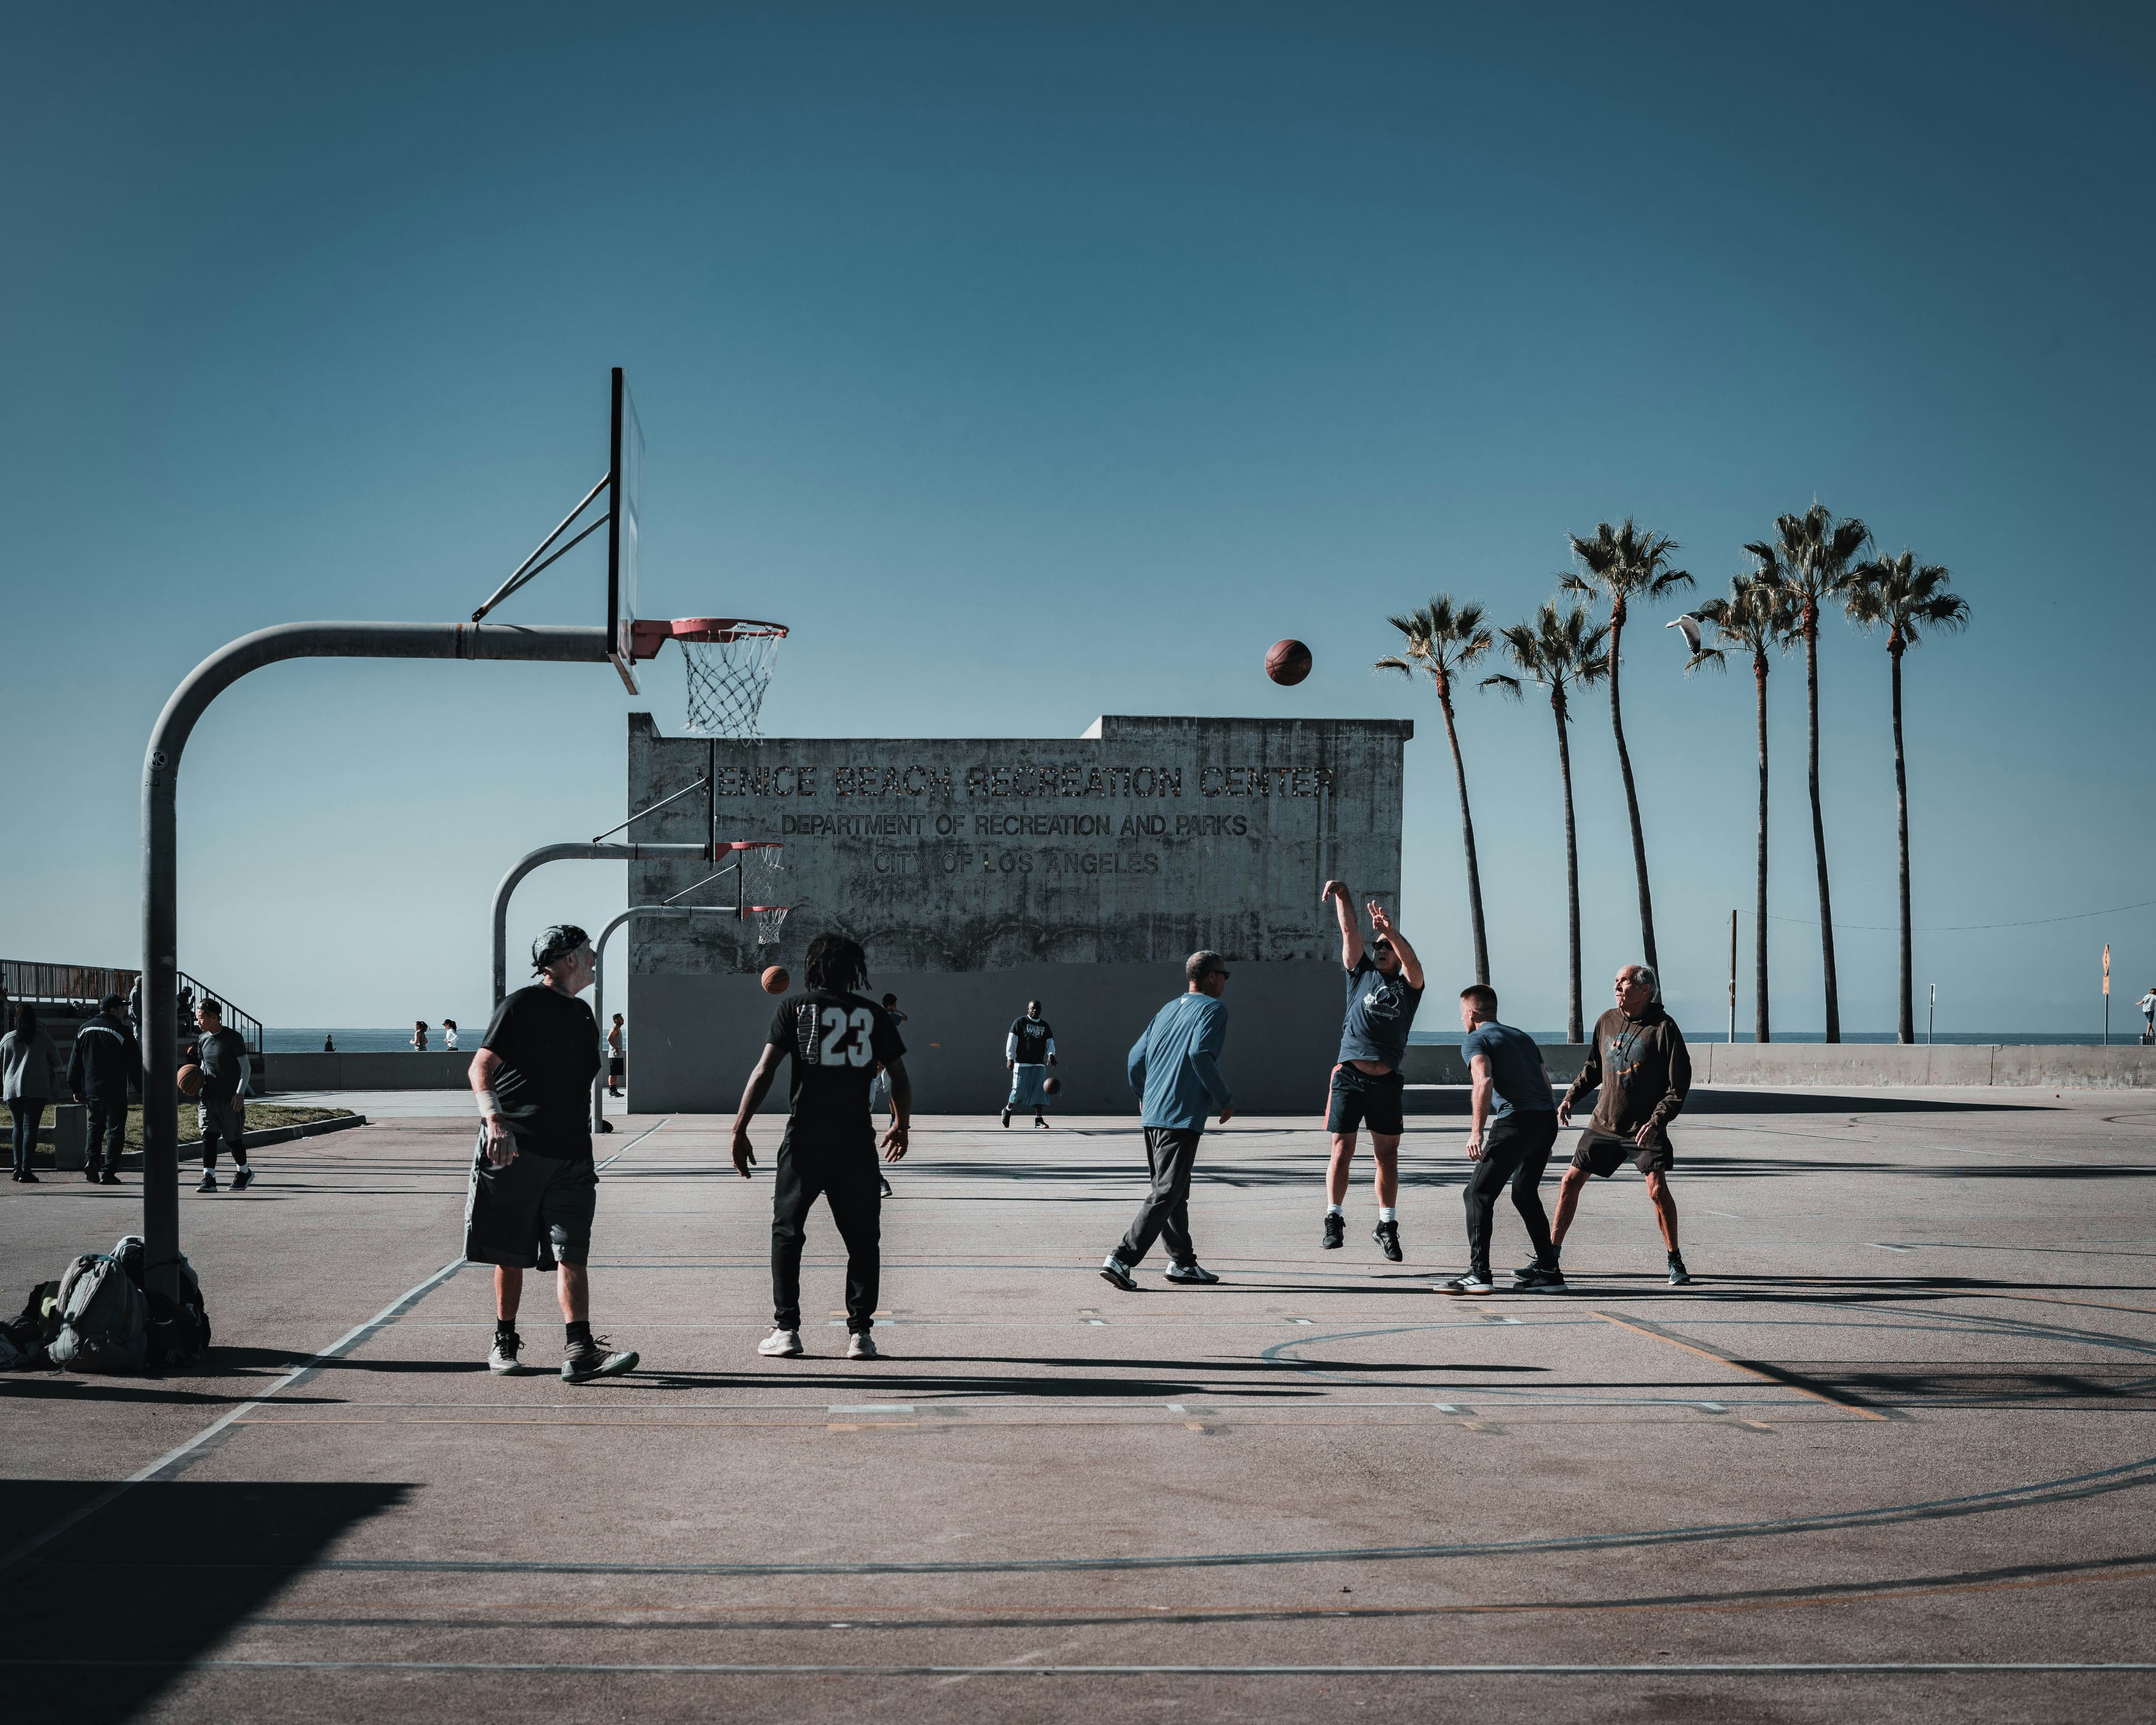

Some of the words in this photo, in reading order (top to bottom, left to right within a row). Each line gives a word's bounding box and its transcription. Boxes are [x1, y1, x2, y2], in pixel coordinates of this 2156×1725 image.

[836, 766, 949, 797] BEACH
[969, 766, 1181, 797] RECREATION
[1200, 766, 1334, 797] CENTER
[782, 814, 926, 835] DEPARTMENT
[935, 814, 966, 835] OF
[975, 814, 1110, 836] RECREATION
[1120, 814, 1166, 836] AND
[1176, 814, 1248, 836] PARKS
[874, 852, 926, 874] CITY
[941, 852, 973, 874] OF
[984, 852, 1034, 874] LOS
[1046, 852, 1158, 874] ANGELES
[796, 1004, 819, 1064] JAMES
[821, 1007, 874, 1067] 23
